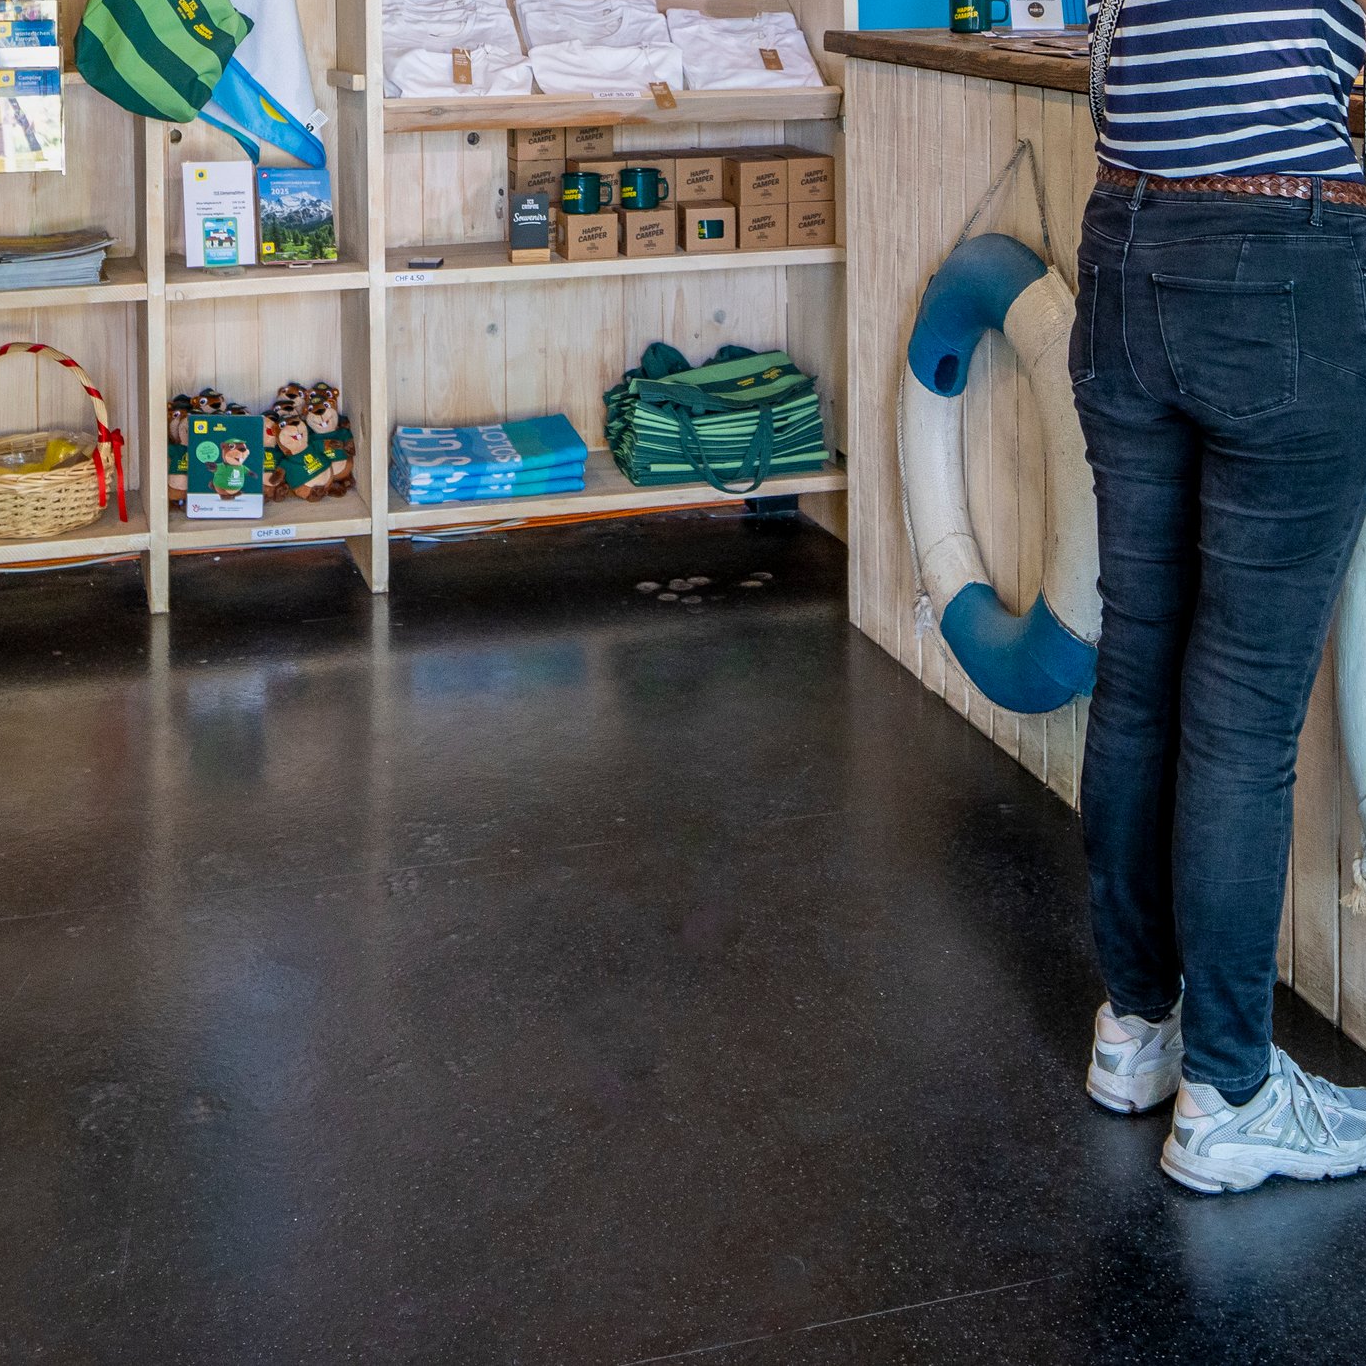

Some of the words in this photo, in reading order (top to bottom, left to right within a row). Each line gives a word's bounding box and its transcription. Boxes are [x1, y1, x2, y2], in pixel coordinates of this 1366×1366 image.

[956, 5, 975, 14] HAPPY
[954, 11, 979, 20] CAMPER
[528, 134, 556, 145] CAMPER
[575, 133, 604, 143] CAMPER
[531, 171, 552, 180] HAPPY
[689, 169, 710, 177] HAPPY
[755, 172, 776, 181] HAPPY
[805, 169, 824, 178] HAPPY
[527, 177, 556, 187] CAMPER
[686, 175, 714, 185] CAMPER
[752, 178, 780, 189] CAMPER
[801, 175, 828, 186] CAMPER
[513, 212, 547, 223] Souvenirs
[752, 215, 772, 224] HAPPY
[802, 212, 822, 221] HAPPY
[639, 223, 660, 232] HAPPY
[748, 221, 776, 232] CAMPER
[798, 218, 826, 229] CAMPER
[581, 226, 603, 235] HAPPY
[635, 229, 664, 240] CAMPER
[577, 232, 608, 243] CAMPER
[410, 274, 425, 282] 4.50
[256, 530, 274, 538] CHF
[275, 528, 291, 536] 8.00
